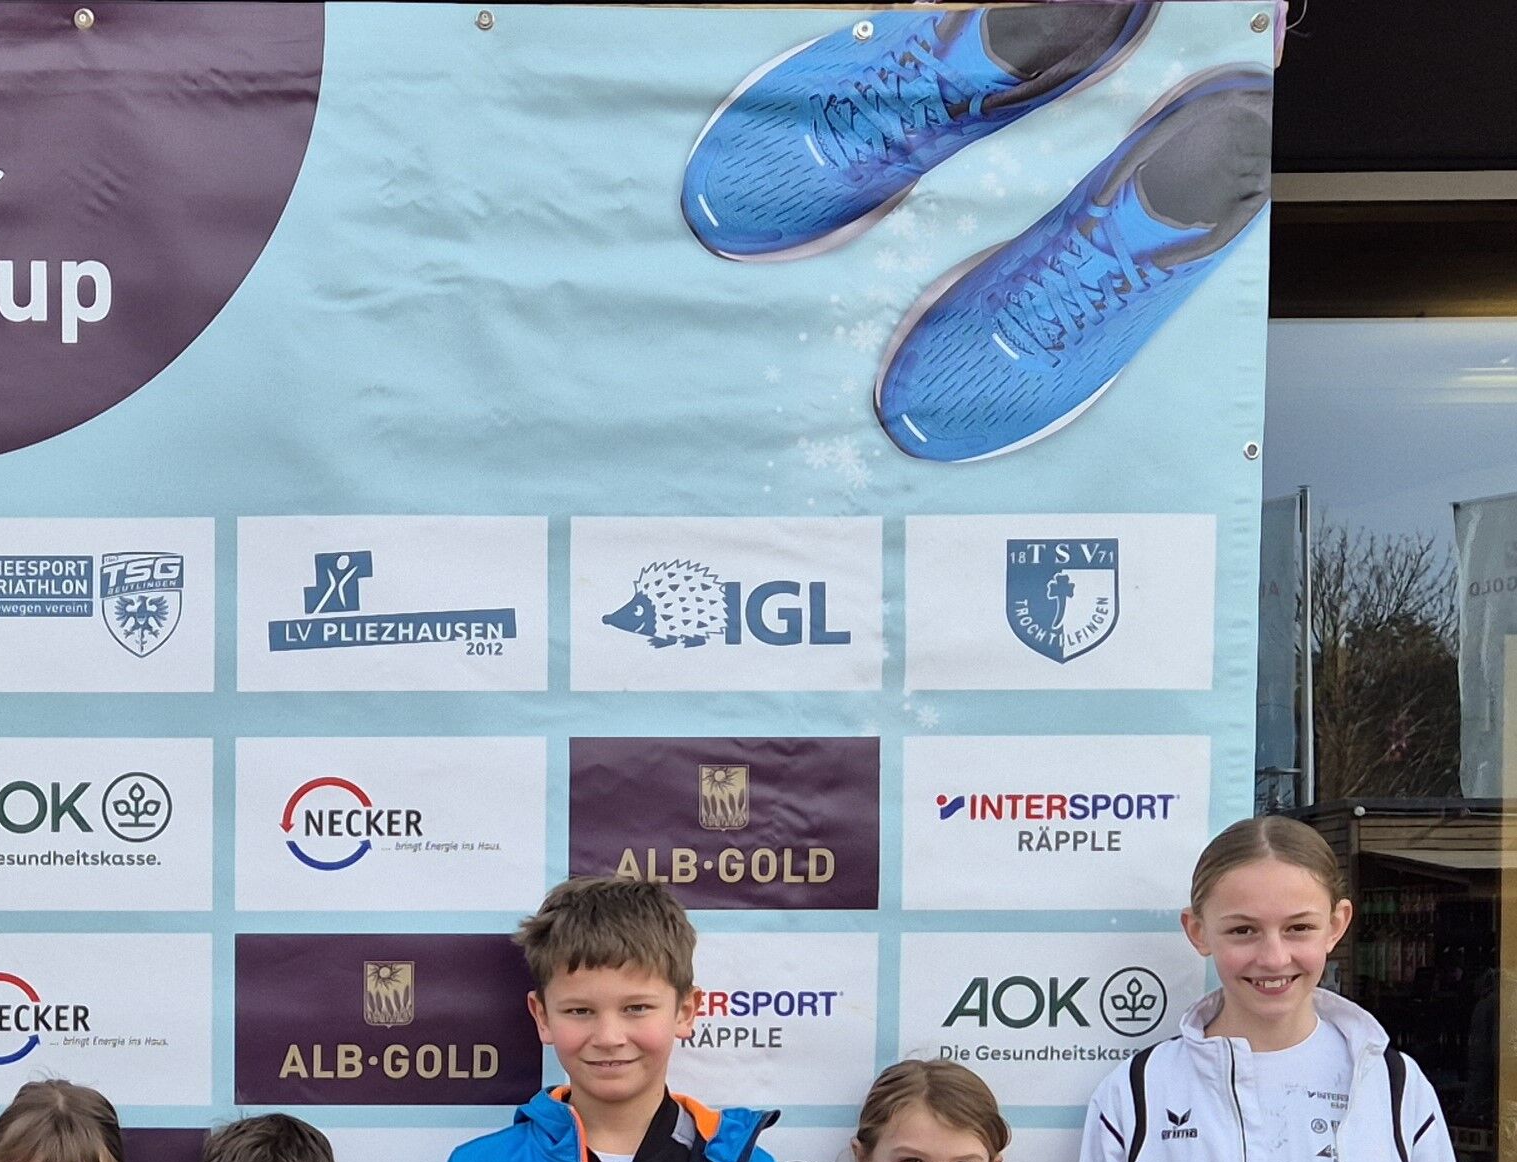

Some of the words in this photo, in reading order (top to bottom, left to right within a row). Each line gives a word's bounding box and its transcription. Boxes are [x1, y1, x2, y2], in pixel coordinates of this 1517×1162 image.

[1010, 551, 1026, 564] 18
[1098, 550, 1114, 564] 71
[102, 557, 182, 588] TSG
[45, 601, 88, 615] vereint
[725, 580, 852, 647] IGL
[285, 622, 314, 643] LV
[322, 620, 506, 643] PLIEZHAUSEN
[465, 641, 504, 657] 2012
[969, 793, 1172, 820] INTERSPORT
[304, 808, 424, 838] NECKER
[395, 840, 422, 854] bringt
[425, 840, 459, 853] Energie
[461, 841, 475, 852] ins
[1017, 827, 1123, 853] RÄPPLE
[941, 975, 1091, 1030] AOK
[278, 1043, 500, 1080] ALB·GOLD
[940, 1045, 972, 1062] Die
[1161, 1125, 1198, 1140] erima
